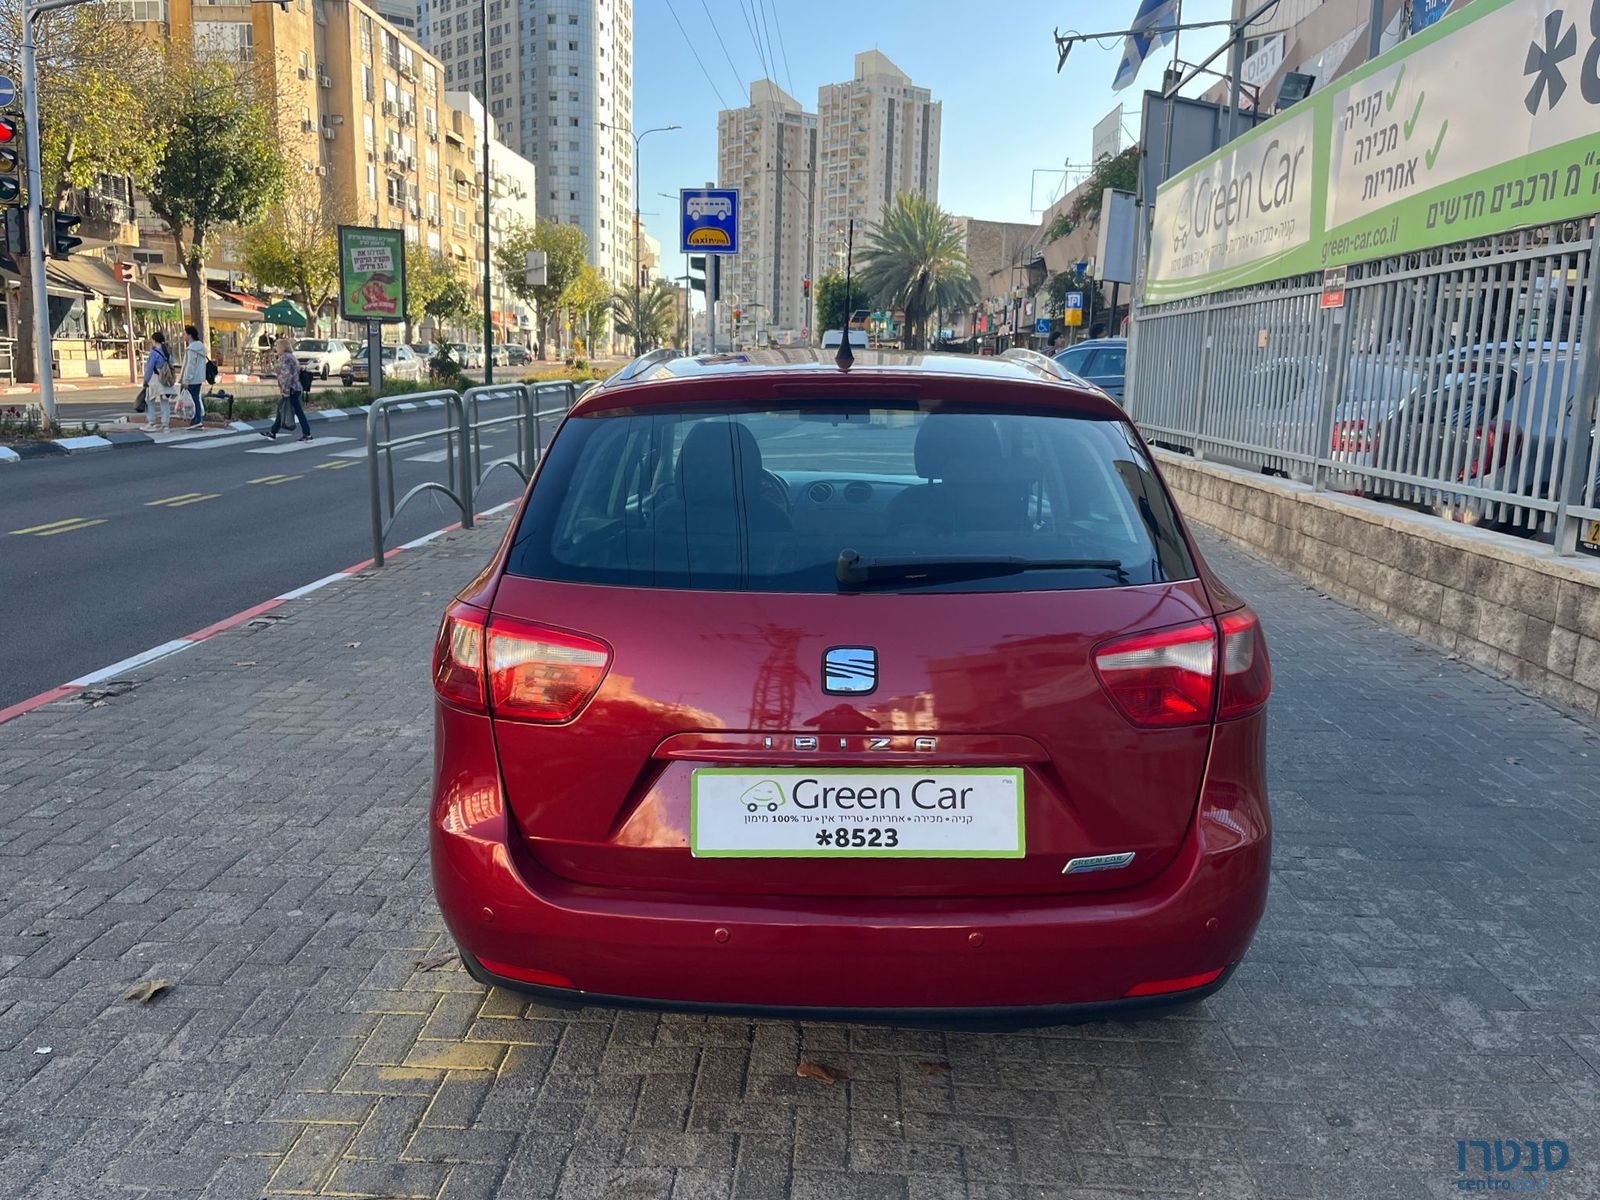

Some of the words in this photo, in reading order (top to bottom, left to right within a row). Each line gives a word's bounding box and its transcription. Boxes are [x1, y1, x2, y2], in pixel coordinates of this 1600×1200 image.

[1248, 45, 1276, 82] דפוס
[1344, 90, 1383, 131] קנייה
[1353, 123, 1398, 165] מכירה
[1362, 156, 1418, 201] אחריות
[1194, 170, 1252, 238] Green
[1258, 139, 1305, 213] Car
[1490, 169, 1558, 214] ורכבים
[1426, 190, 1486, 229] חדשים
[1280, 219, 1295, 241] קניה
[1321, 216, 1399, 264] green-car.co.il
[765, 736, 937, 752] IBIZA
[792, 779, 900, 810] Green
[912, 779, 974, 810] Car
[744, 815, 769, 824] מימון
[772, 815, 799, 823] 100%
[801, 815, 813, 823] עד
[821, 815, 835, 824] אין
[839, 815, 863, 823] טרייד
[872, 815, 905, 823] אחריות
[914, 815, 943, 823] מכירה
[952, 815, 973, 824] קניה
[1071, 858, 1102, 866] GREEN
